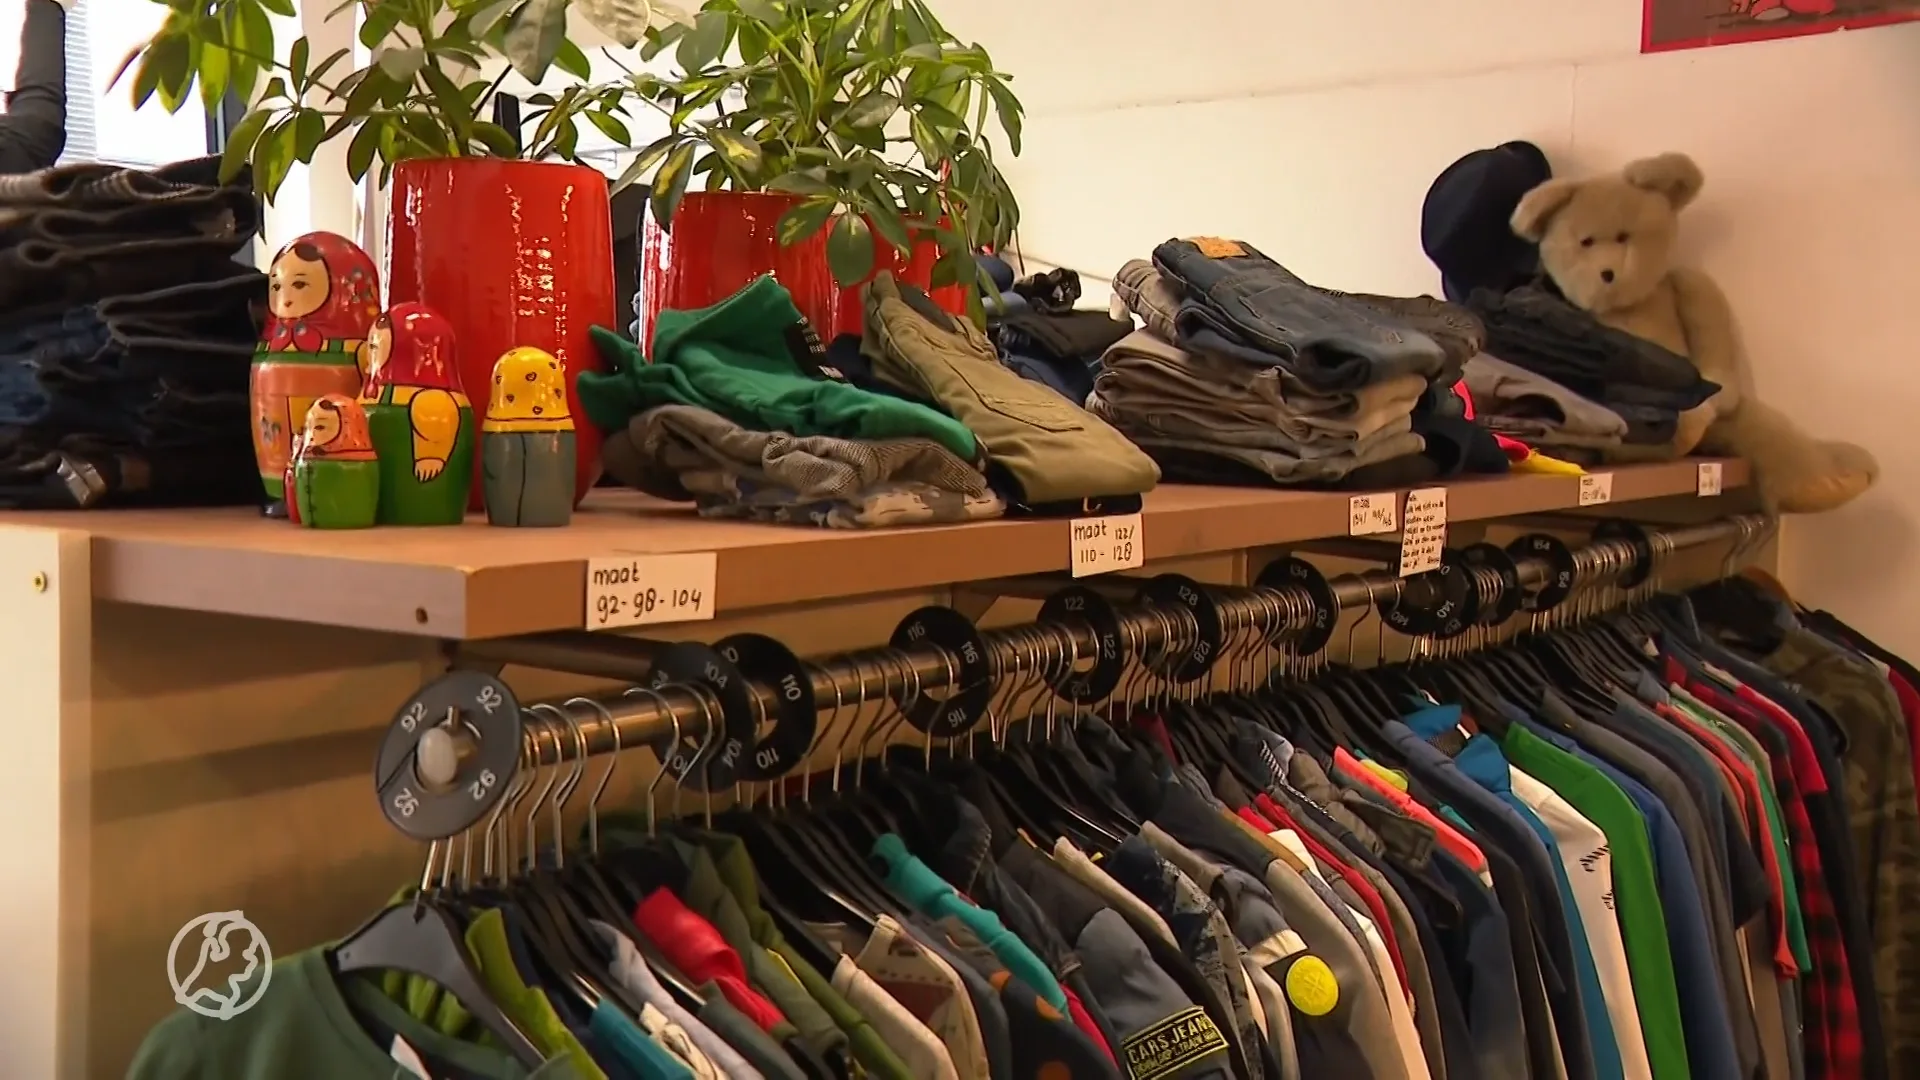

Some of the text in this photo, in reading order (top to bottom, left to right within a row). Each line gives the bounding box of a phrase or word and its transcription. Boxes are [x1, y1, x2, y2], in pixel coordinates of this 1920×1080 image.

[1074, 520, 1107, 541] maat
[593, 561, 640, 585] maat
[1064, 596, 1085, 611] 122
[1178, 585, 1199, 606] 128
[907, 621, 926, 641] 116
[961, 641, 980, 664] 116
[1103, 633, 1116, 660] 122
[1193, 640, 1212, 664] 128
[704, 660, 729, 690] 104
[780, 673, 802, 701] 110
[475, 685, 503, 714] 92
[400, 702, 429, 733] 92
[947, 707, 968, 728] 116
[721, 737, 744, 769] 104
[755, 747, 780, 770] 110
[468, 768, 497, 801] 92
[394, 787, 420, 818] 92
[1128, 1034, 1170, 1064] CARS
